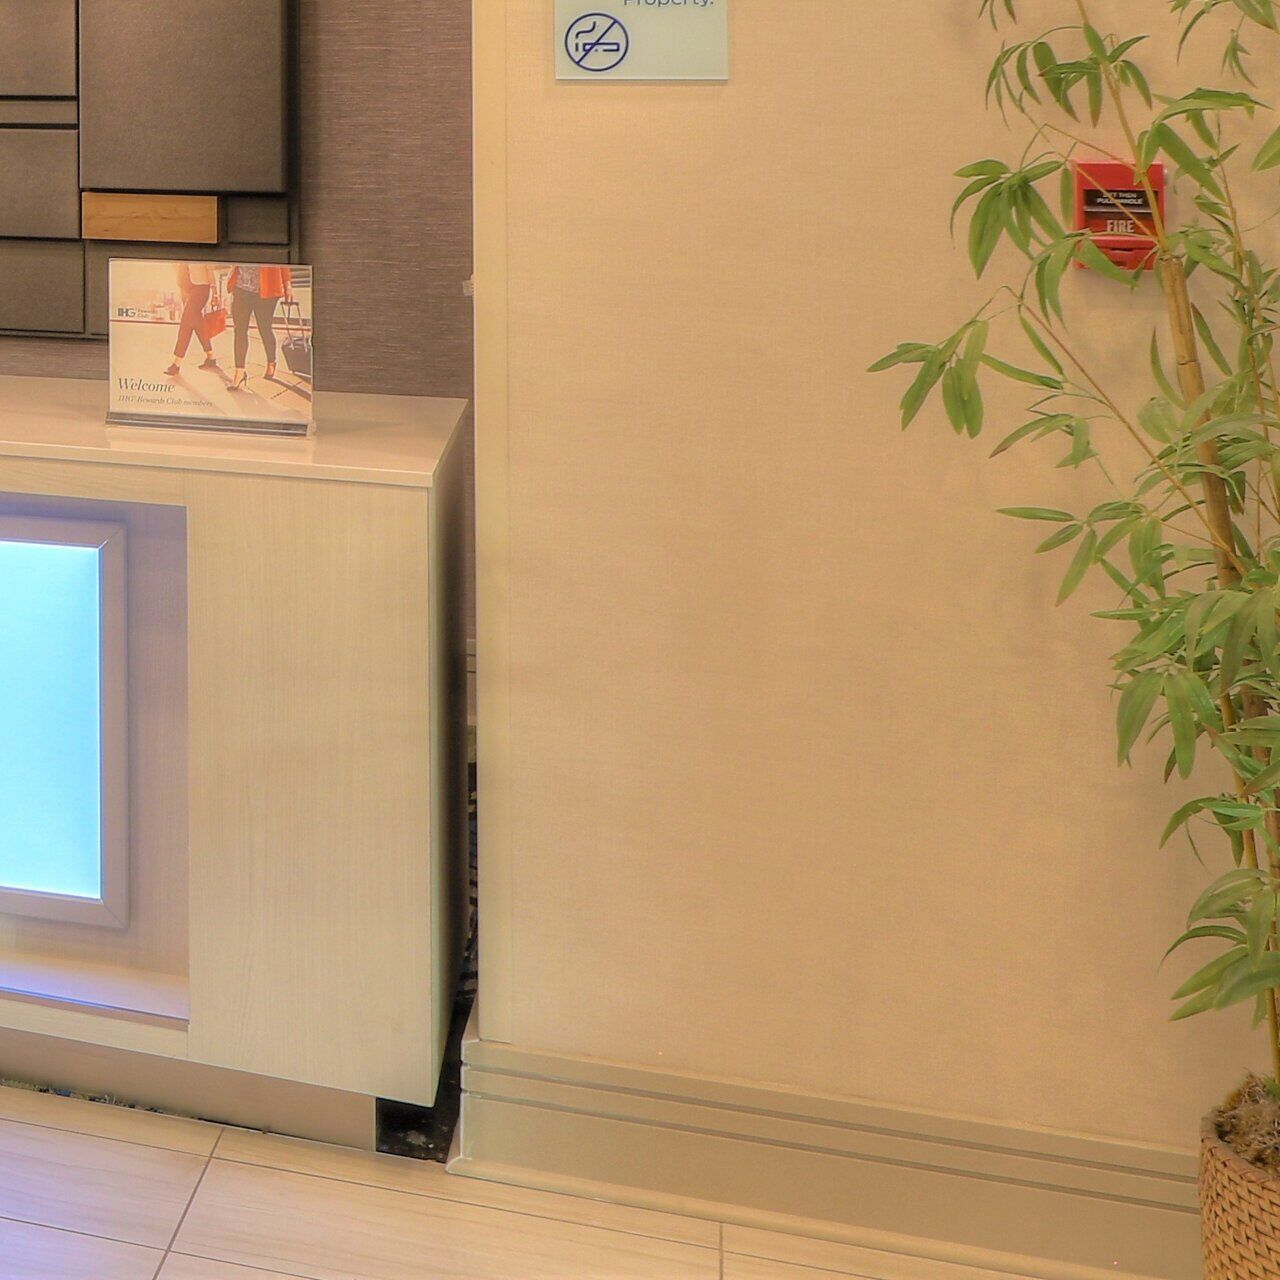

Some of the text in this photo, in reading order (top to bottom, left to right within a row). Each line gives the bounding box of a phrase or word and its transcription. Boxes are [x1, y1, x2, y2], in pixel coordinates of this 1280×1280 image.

[1107, 220, 1135, 233] FIRE
[117, 307, 136, 318] IHG
[118, 377, 175, 393] Welcome
[137, 395, 165, 405] Rewards
[166, 397, 182, 406] Club
